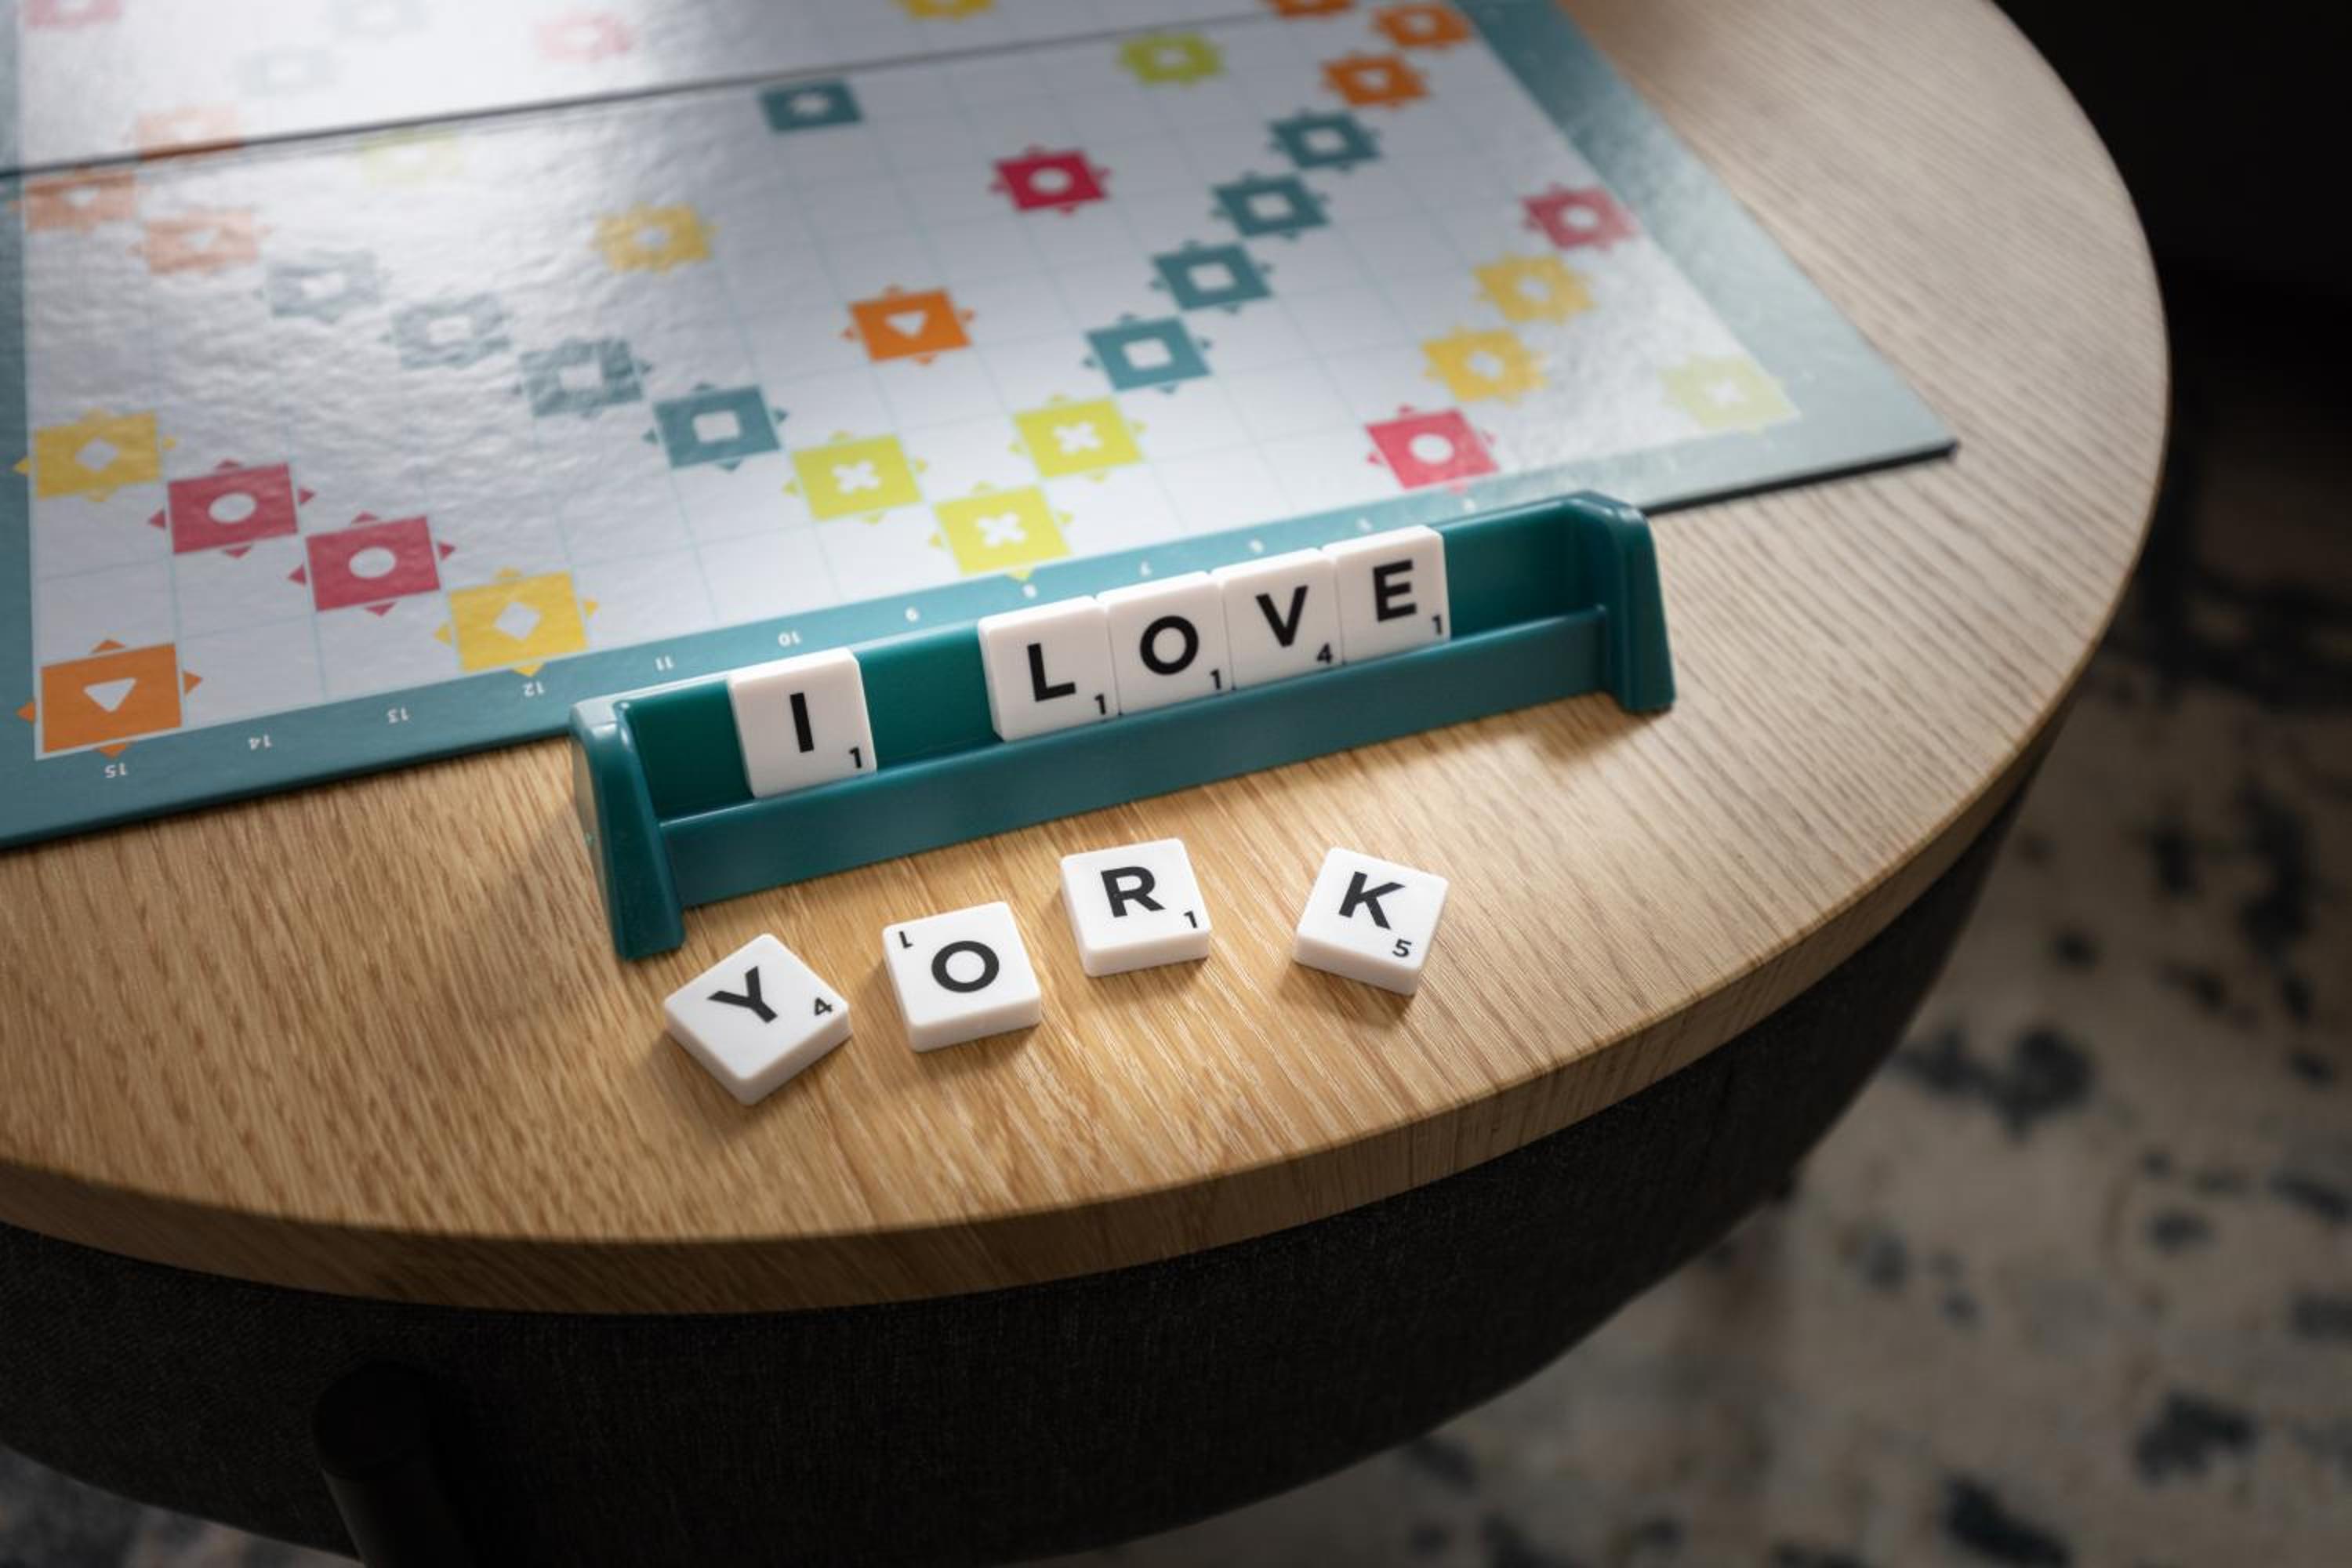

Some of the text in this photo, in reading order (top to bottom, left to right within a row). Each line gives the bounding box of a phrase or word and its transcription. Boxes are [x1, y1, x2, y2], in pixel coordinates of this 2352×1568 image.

[1432, 613, 1444, 637] 1
[789, 558, 1418, 753] I LOVE
[1316, 642, 1335, 666] 4
[1210, 668, 1223, 691] 1
[1094, 692, 1108, 717] 1
[848, 746, 863, 769] 1
[103, 762, 126, 779] 15
[1185, 910, 1198, 929] 1
[1392, 938, 1413, 958] 5
[814, 997, 833, 1017] 4
